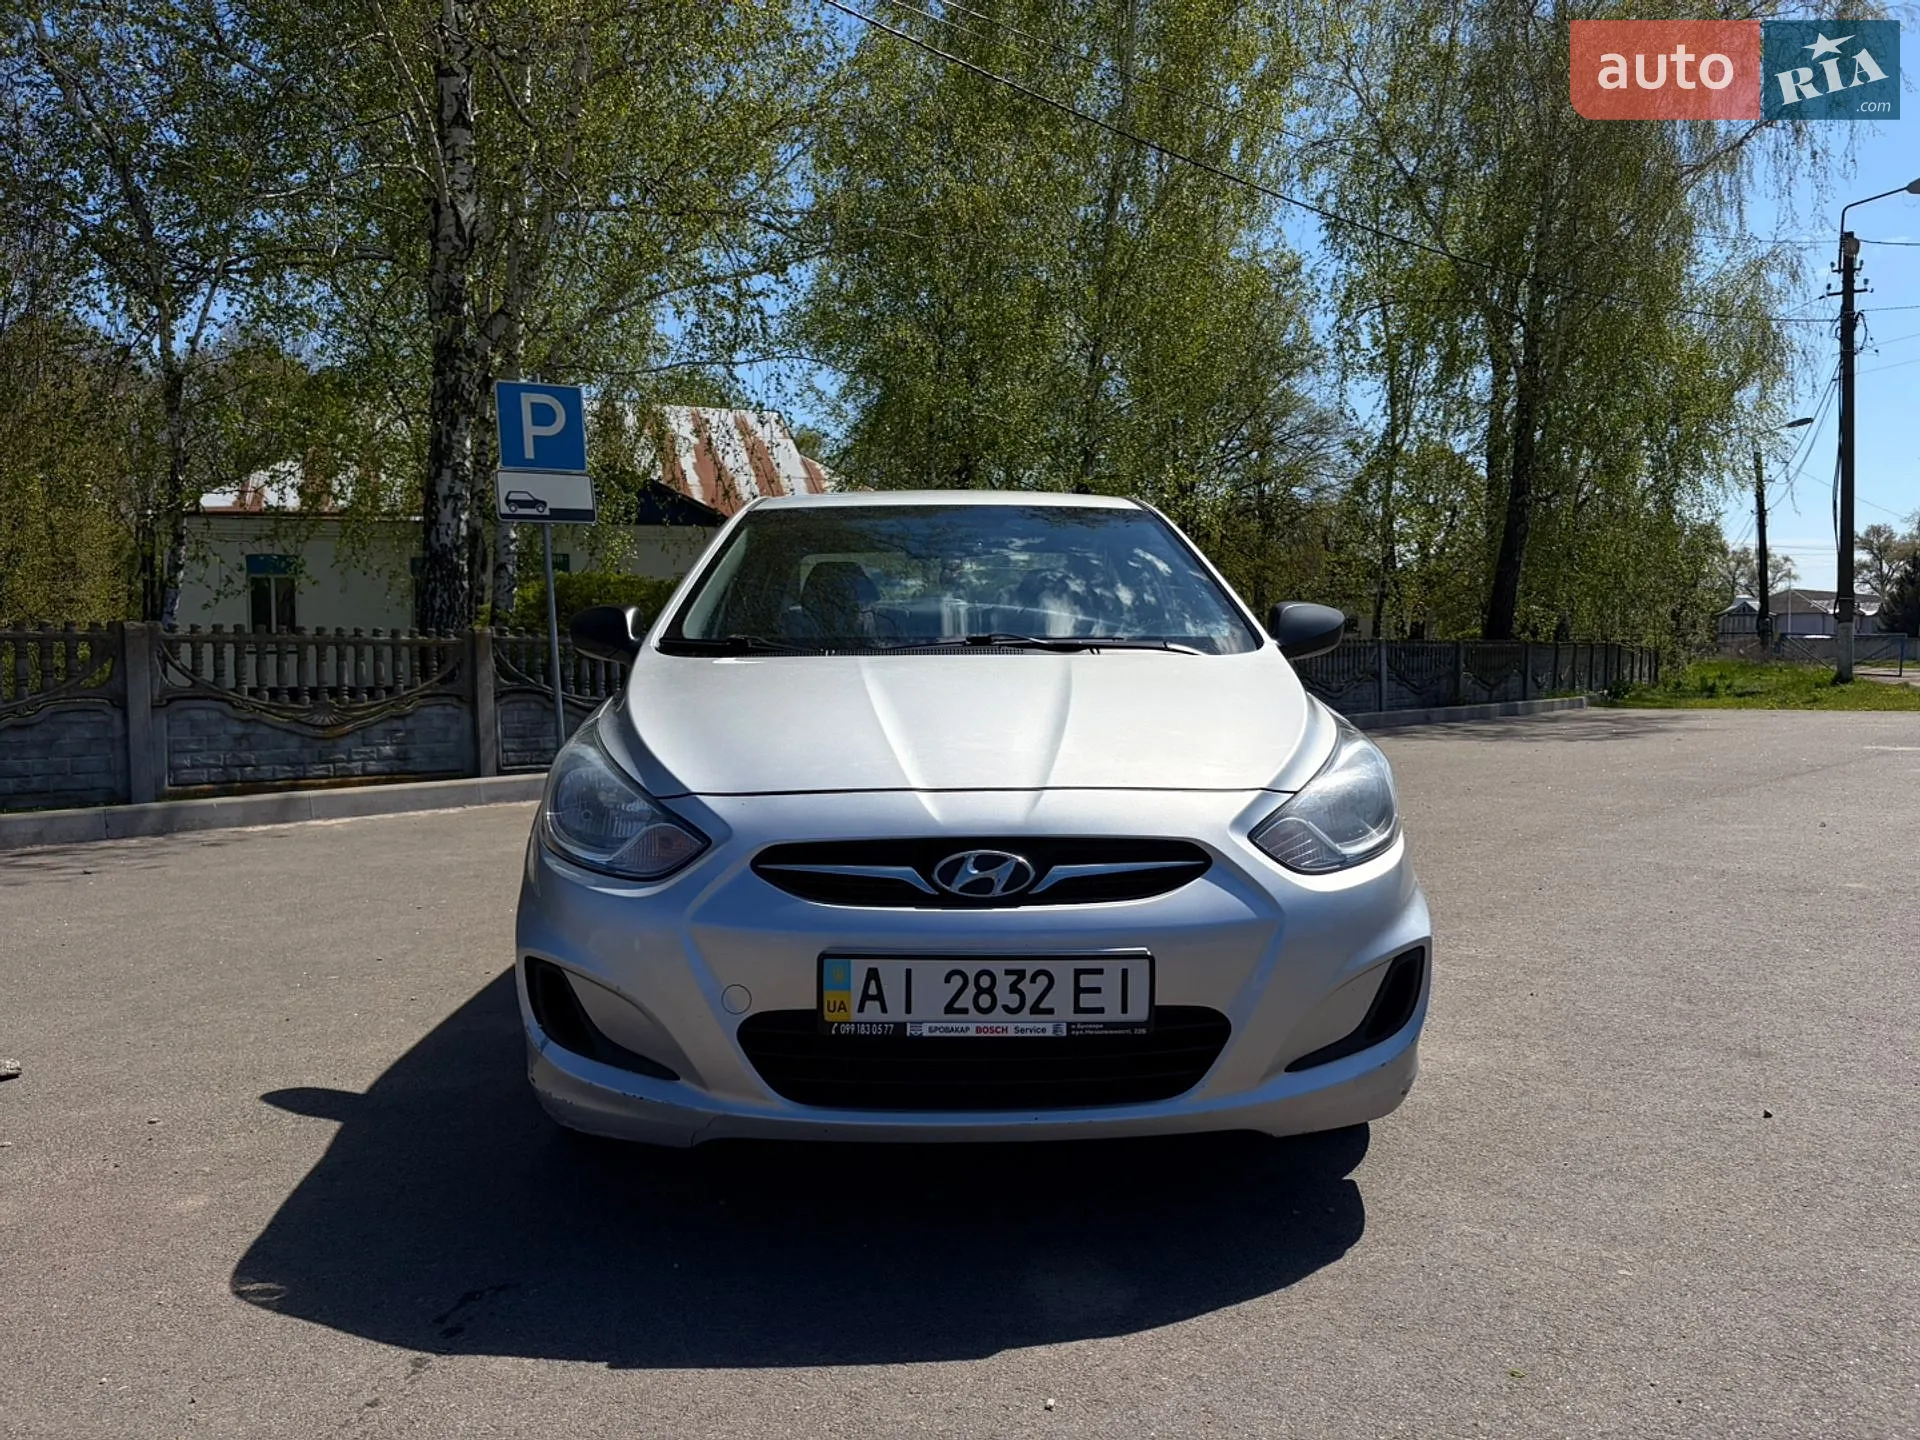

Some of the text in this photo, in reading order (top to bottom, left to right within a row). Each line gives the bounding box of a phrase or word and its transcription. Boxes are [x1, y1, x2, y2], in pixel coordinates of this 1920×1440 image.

[520, 392, 566, 459] P
[826, 999, 848, 1013] UA
[857, 967, 1129, 1015] AI 2832 EI
[975, 1025, 1009, 1034] BOSCH
[1013, 1025, 1047, 1034] Service
